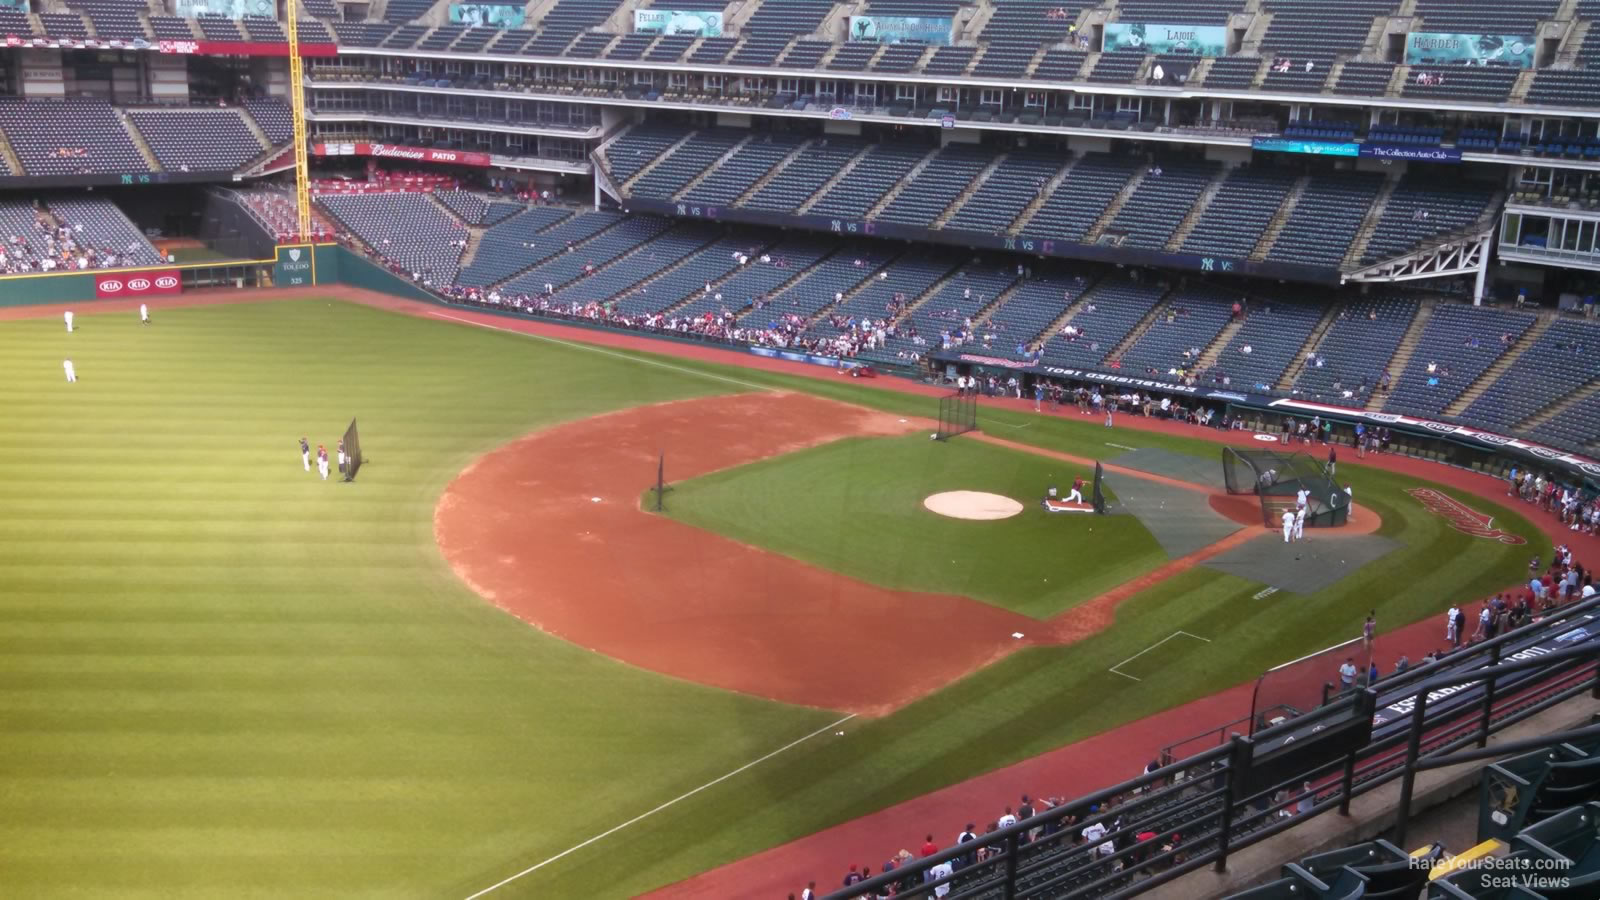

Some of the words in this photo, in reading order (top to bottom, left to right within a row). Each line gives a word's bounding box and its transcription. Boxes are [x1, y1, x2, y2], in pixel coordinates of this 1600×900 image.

[639, 12, 665, 23] FELLER
[1167, 30, 1195, 40] LAJOIE
[1414, 37, 1460, 49] HARDER
[369, 144, 424, 159] Budweiser
[432, 152, 457, 161] PATIO
[1373, 147, 1387, 156] The
[1387, 148, 1416, 158] Collection
[1416, 149, 1431, 158] Auto
[1431, 150, 1447, 159] Club
[283, 263, 310, 271] TOLEDO
[103, 281, 121, 290] KIA
[130, 280, 149, 289] KIA
[157, 278, 176, 287] KIA
[1086, 371, 1198, 393] ESTABLISHED
